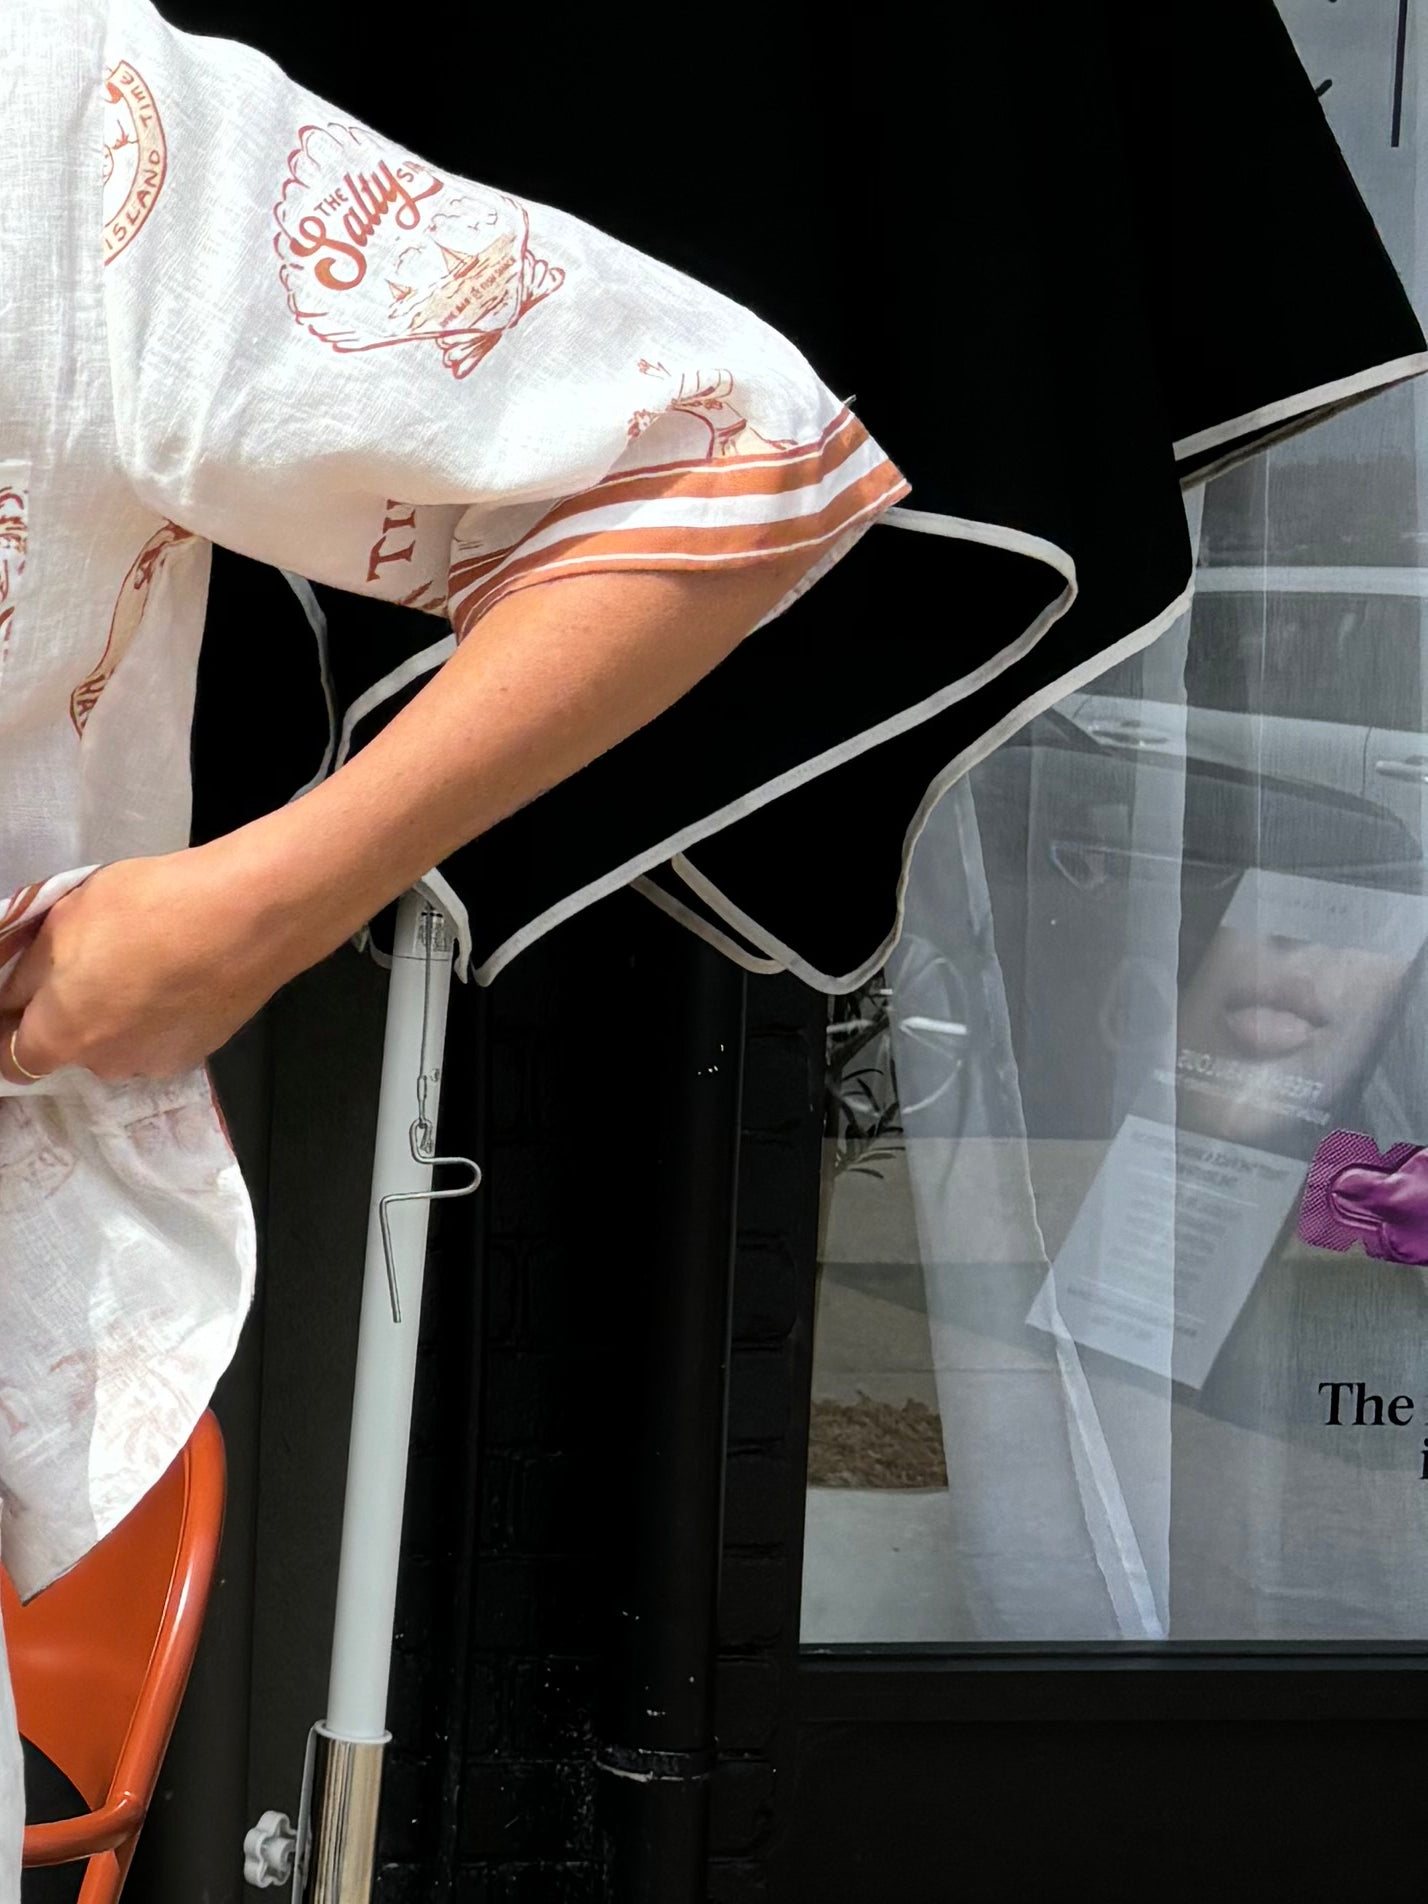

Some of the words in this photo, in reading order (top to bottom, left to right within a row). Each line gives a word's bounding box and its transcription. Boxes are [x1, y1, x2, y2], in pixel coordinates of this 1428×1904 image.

[120, 73, 156, 129] TIME
[105, 149, 160, 252] ISLAND
[289, 159, 444, 291] Salty
[313, 187, 349, 217] THE
[366, 498, 417, 583] TI
[1318, 1382, 1415, 1426] The
